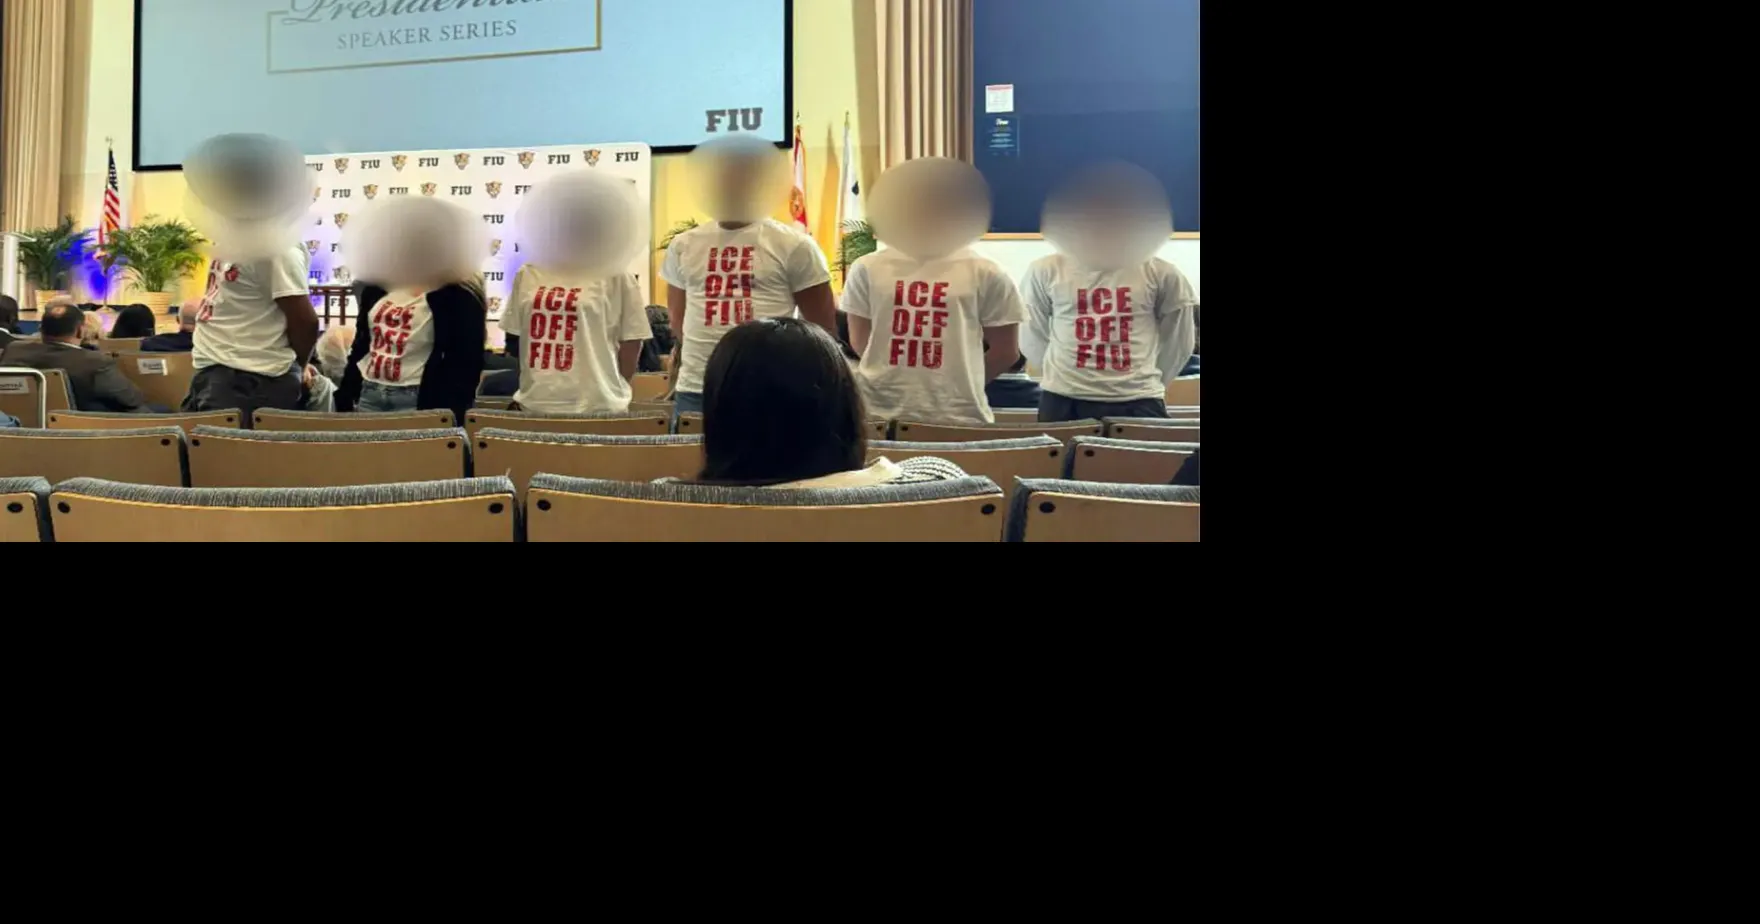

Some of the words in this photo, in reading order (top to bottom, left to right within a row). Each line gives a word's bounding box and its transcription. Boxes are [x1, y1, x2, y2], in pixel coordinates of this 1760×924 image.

[337, 25, 432, 50] SPEAKER
[439, 19, 518, 41] SERIES
[705, 108, 763, 132] FIU
[360, 159, 381, 169] FIU
[418, 157, 439, 167] FIU
[483, 156, 505, 166] FIU
[548, 154, 571, 164] FIU
[616, 151, 640, 162] FIU
[331, 188, 352, 198] FIU
[450, 185, 472, 195] FIU
[707, 246, 755, 272] ICE
[532, 286, 582, 312] ICE
[704, 273, 755, 299] OFF
[895, 280, 949, 308] ICE
[704, 299, 754, 326] FIU
[1077, 287, 1133, 315] ICE
[373, 301, 416, 330] ICE
[528, 312, 578, 341] OFF
[891, 309, 949, 338] OFF
[371, 326, 410, 356] OFF
[1075, 316, 1134, 343] OFF
[528, 342, 575, 372] FIU
[889, 338, 943, 369] FIU
[1076, 344, 1131, 371] FIU
[366, 353, 402, 382] FIU
